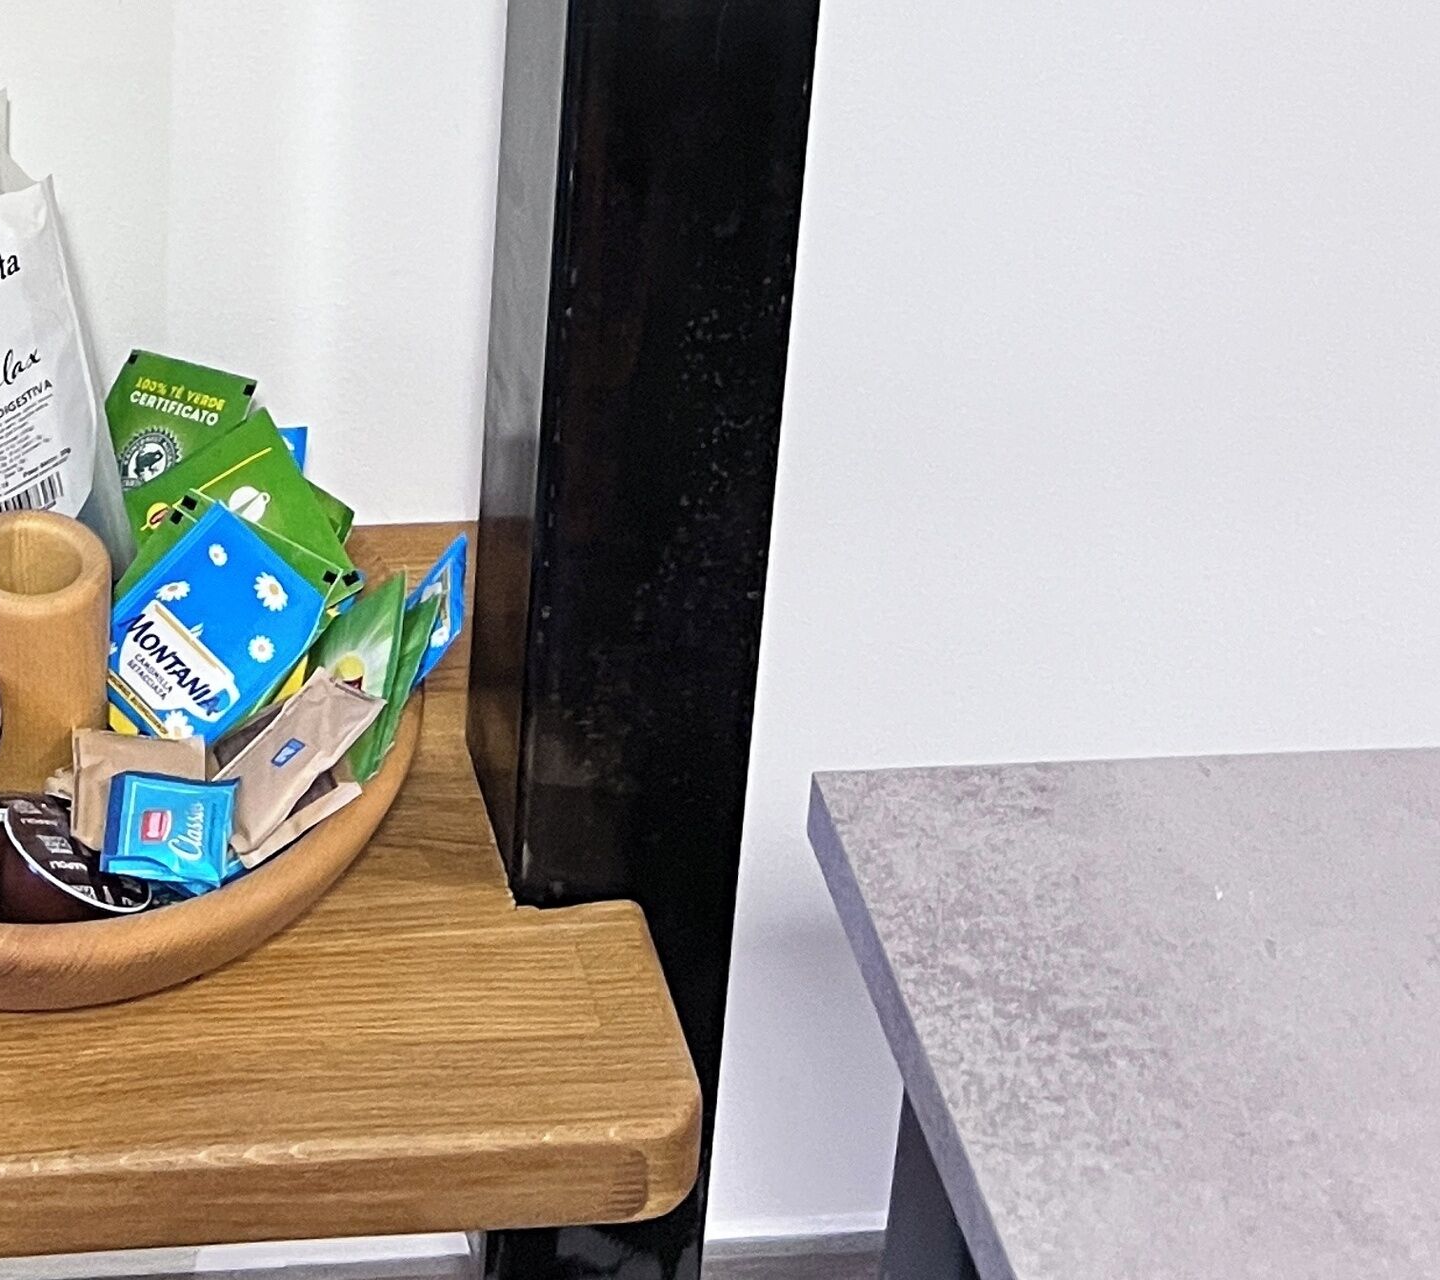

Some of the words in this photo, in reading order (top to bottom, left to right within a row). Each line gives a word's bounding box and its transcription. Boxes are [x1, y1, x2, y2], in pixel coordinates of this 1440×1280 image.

[129, 390, 219, 426] CERTIFICATO
[187, 390, 227, 411] VERDE
[118, 613, 221, 716] MONTANIA
